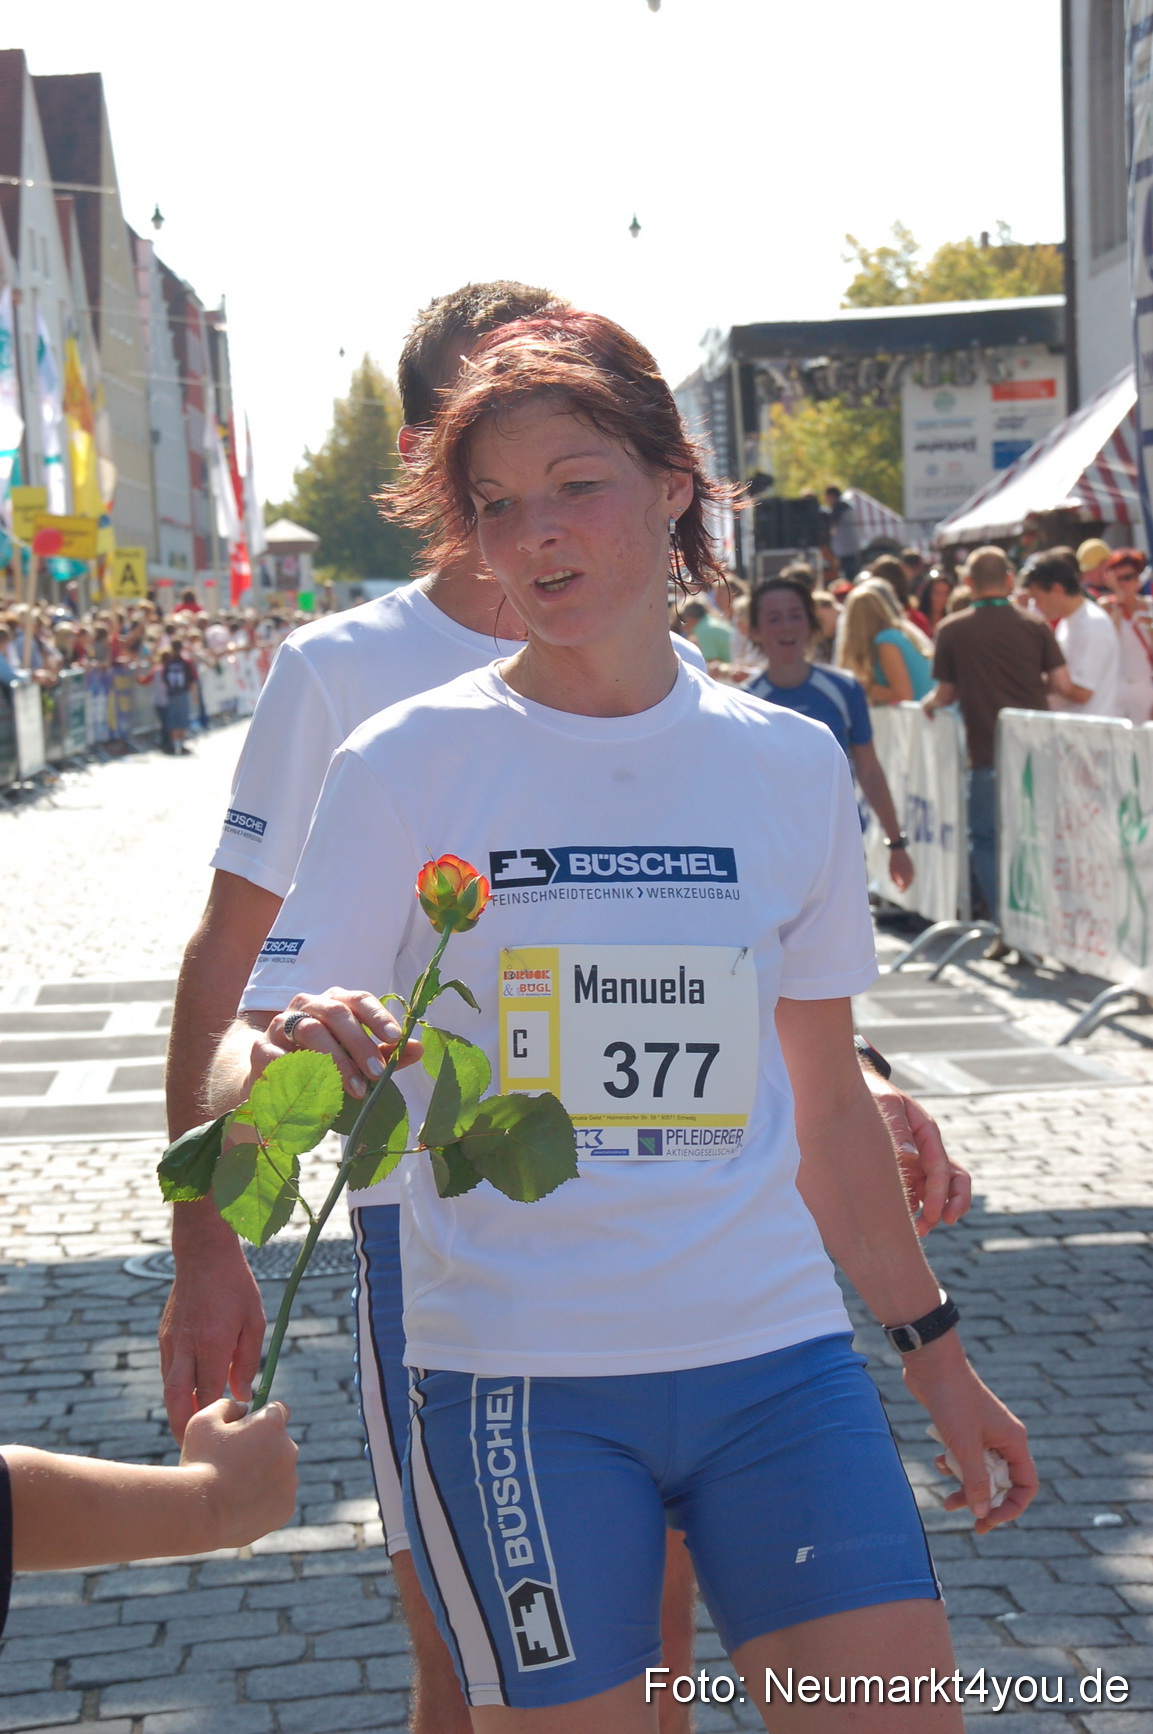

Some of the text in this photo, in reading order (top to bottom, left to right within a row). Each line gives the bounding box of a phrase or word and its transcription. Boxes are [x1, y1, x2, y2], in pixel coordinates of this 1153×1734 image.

[120, 563, 137, 586] A
[568, 852, 728, 876] BÜSCHEL
[492, 887, 740, 907] FEINSCHNEIDTECHNIK WERKZEUGBAU
[264, 941, 299, 952] ÜSCHEL
[574, 964, 705, 1005] Manuela
[513, 1029, 528, 1059] C
[603, 1041, 720, 1099] 377
[666, 1128, 744, 1146] PFLEIDERER
[666, 1147, 738, 1157] AKTIENGESELLSCHA
